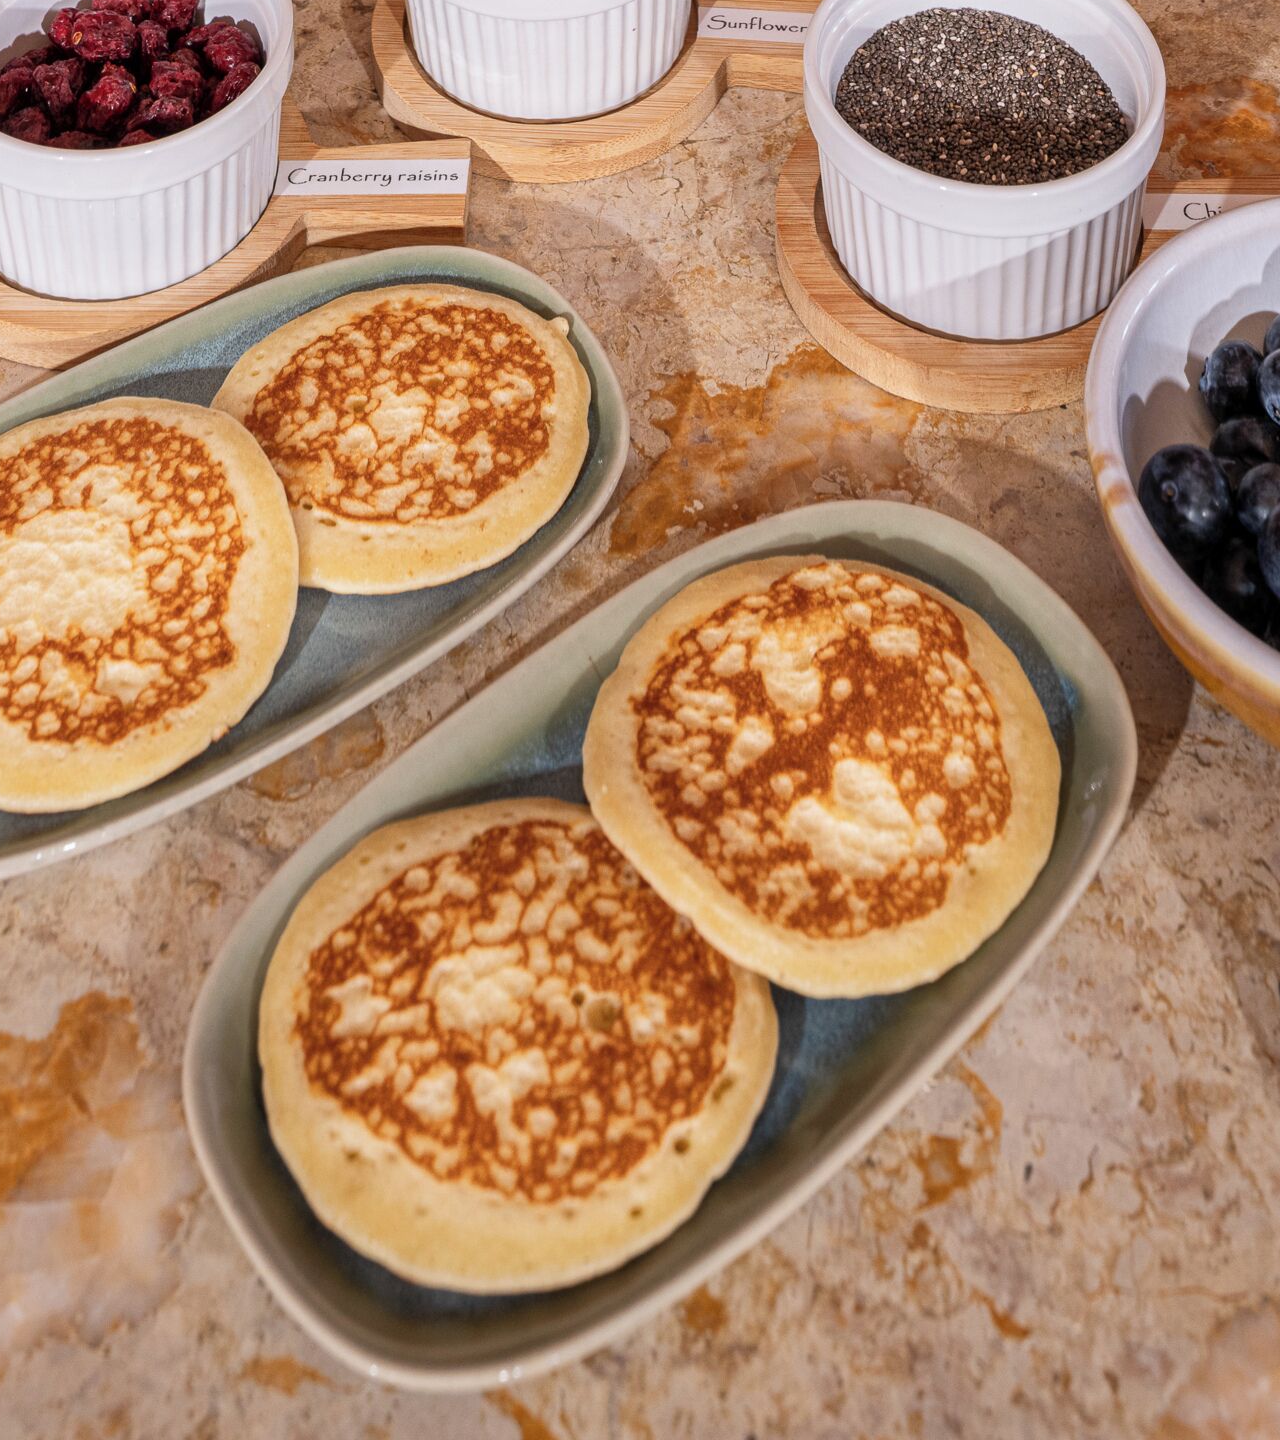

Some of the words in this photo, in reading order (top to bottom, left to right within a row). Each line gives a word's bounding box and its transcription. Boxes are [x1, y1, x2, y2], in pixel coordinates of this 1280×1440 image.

[707, 15, 808, 32] Sunflower
[287, 168, 392, 187] Cranberry
[398, 170, 459, 182] raisins
